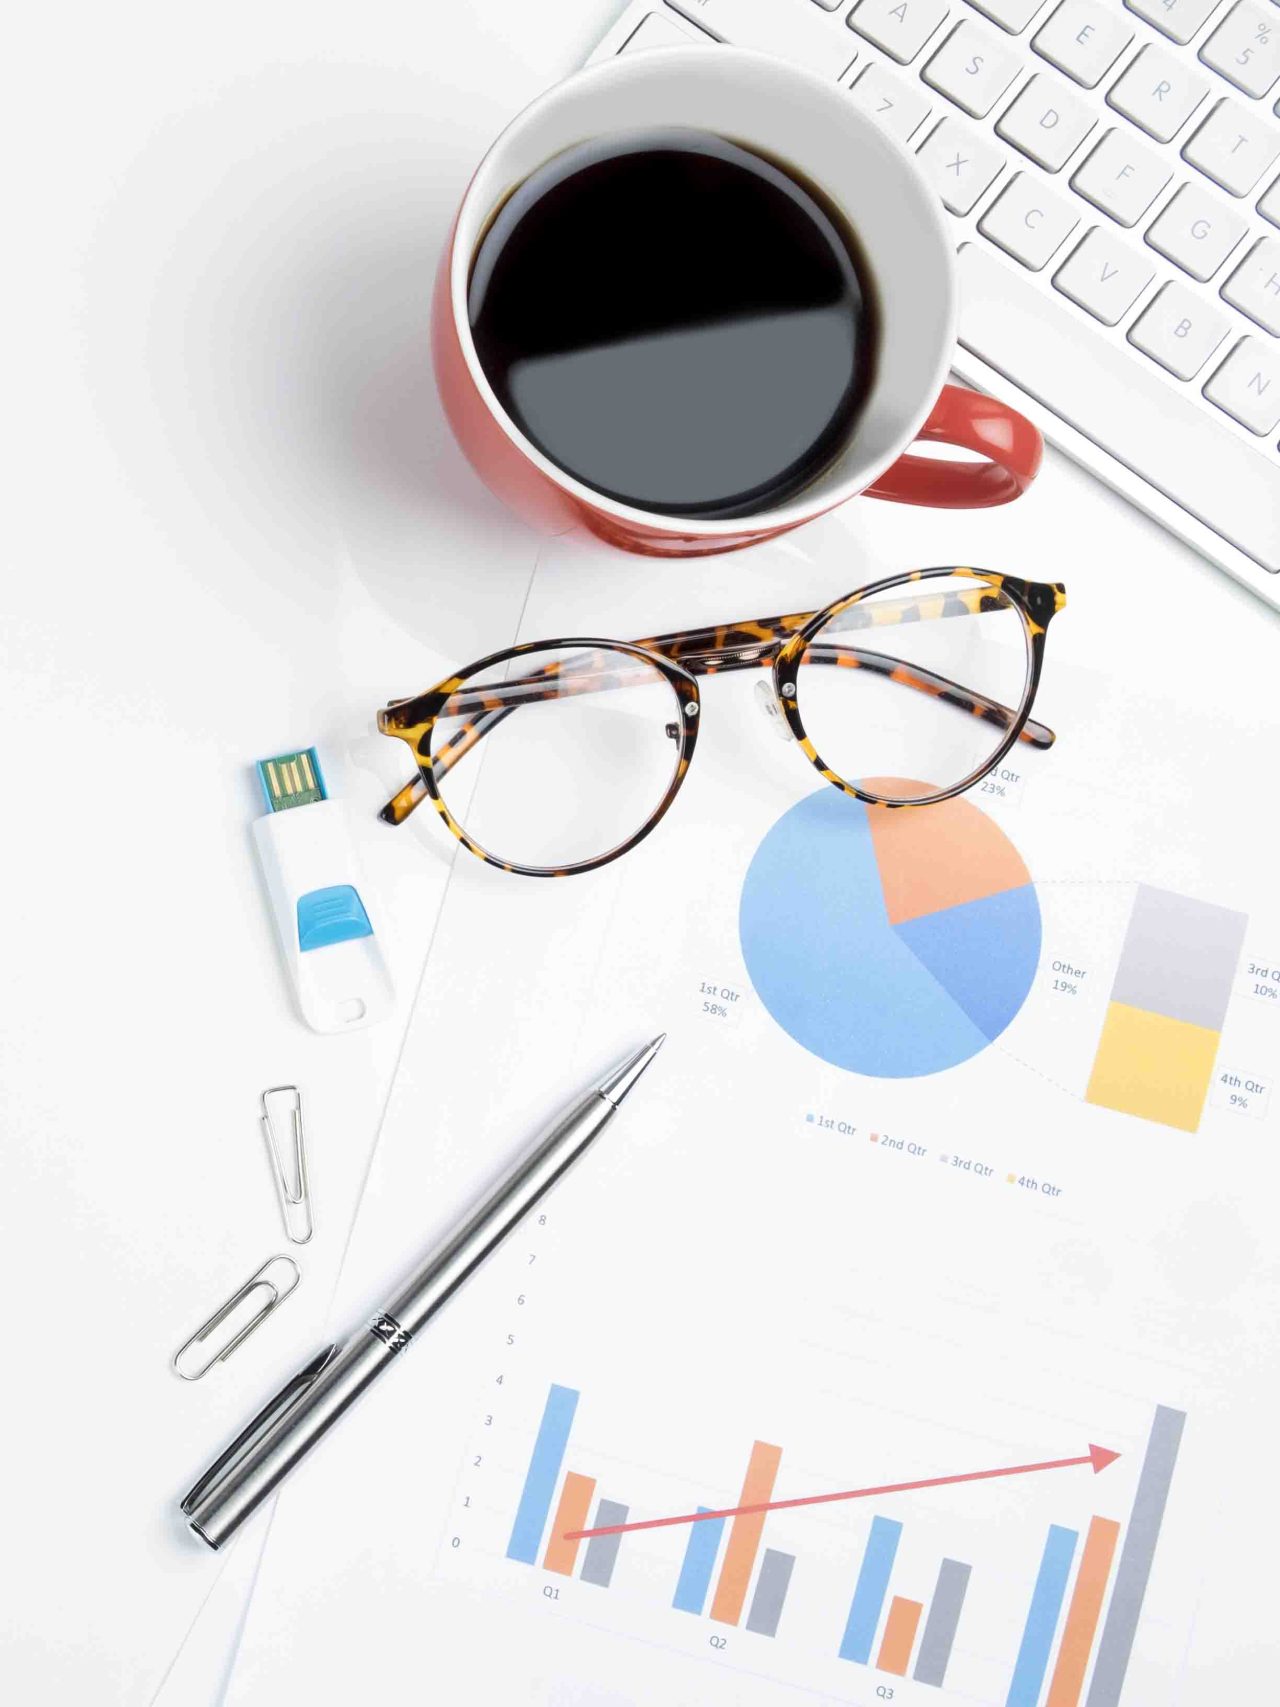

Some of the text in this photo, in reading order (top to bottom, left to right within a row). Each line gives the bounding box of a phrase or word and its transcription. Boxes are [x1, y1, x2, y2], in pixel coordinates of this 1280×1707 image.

[888, 2, 908, 24] A
[1075, 24, 1096, 45] E
[1254, 22, 1273, 45] %
[1235, 47, 1255, 66] 5
[964, 56, 984, 76] S
[1151, 79, 1172, 102] R
[1039, 108, 1060, 130] D
[1231, 134, 1249, 154] T
[945, 151, 970, 177] X
[1115, 163, 1136, 181] F
[1024, 208, 1045, 230] C
[1190, 219, 1212, 240] G
[1099, 262, 1119, 283] V
[1173, 318, 1193, 339] B
[1247, 371, 1271, 396] N
[1000, 769, 1021, 783] Qtr
[980, 780, 1006, 797] 23%
[1051, 960, 1087, 979] Other
[1247, 963, 1269, 978] 3rd
[699, 981, 741, 1002] 1st Qtr
[1052, 979, 1077, 995] 19%
[1253, 983, 1278, 999] 10%
[702, 1001, 728, 1018] 58%
[1220, 1073, 1266, 1095] 4th Qtr
[1229, 1094, 1248, 1109] 9%
[817, 1115, 1062, 1197] 1st Qtr 2nd Qtr 3rd Qtr 4th Qtr
[538, 1214, 547, 1226] 8
[528, 1254, 537, 1265] 7
[517, 1294, 526, 1306] 6
[506, 1333, 515, 1346] 5
[495, 1374, 504, 1386] 4
[484, 1414, 493, 1426] 3
[473, 1455, 482, 1467] 2
[463, 1496, 471, 1508] 1
[451, 1536, 461, 1549] 0
[542, 1585, 560, 1601] Q1
[709, 1635, 728, 1650] Q2
[875, 1685, 895, 1700] Q3
